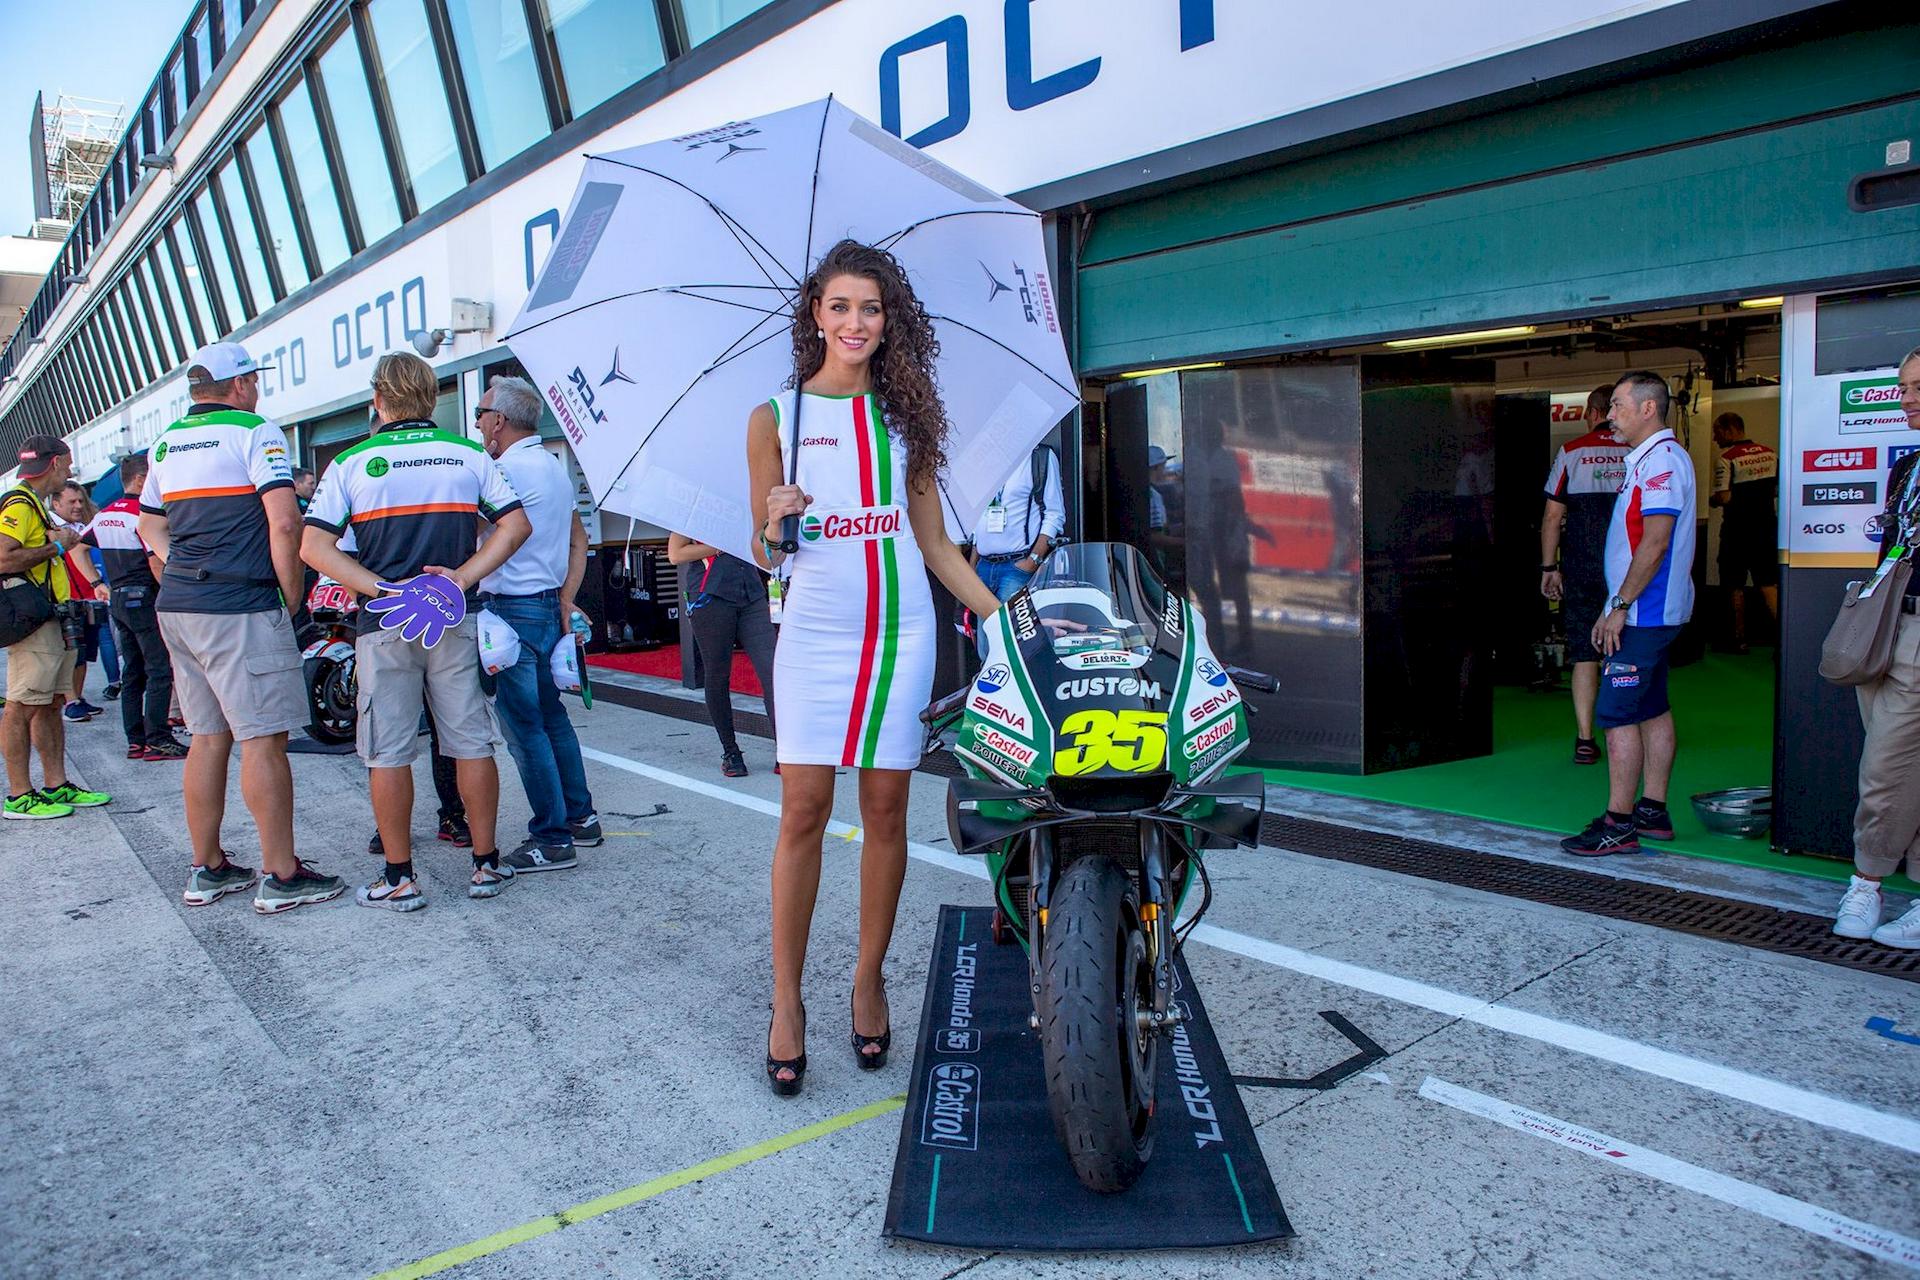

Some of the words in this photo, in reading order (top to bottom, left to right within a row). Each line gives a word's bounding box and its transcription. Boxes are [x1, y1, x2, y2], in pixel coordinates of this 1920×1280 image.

[332, 275, 428, 369] OCTO
[254, 337, 307, 397] CTO
[1551, 404, 1590, 422] Ra
[389, 432, 434, 441] LCR
[803, 437, 838, 447] Castrol
[1814, 451, 1864, 468] GIVI
[1828, 488, 1864, 500] Beta
[97, 519, 125, 528] HONDA
[824, 509, 900, 539] Castrol
[1803, 523, 1845, 534] AGOS
[1014, 595, 1037, 641] rizoma
[1160, 590, 1180, 638] rizoma
[982, 667, 1008, 685] SIFI
[1198, 660, 1220, 680] SIFI
[1056, 676, 1162, 701] CUSTOM
[972, 696, 1025, 731] SENA
[1190, 689, 1238, 722] SENA
[987, 732, 1034, 764] Castrol
[1054, 709, 1169, 777] 35
[1197, 717, 1234, 751] Castrol
[931, 1079, 973, 1142] Castrol
